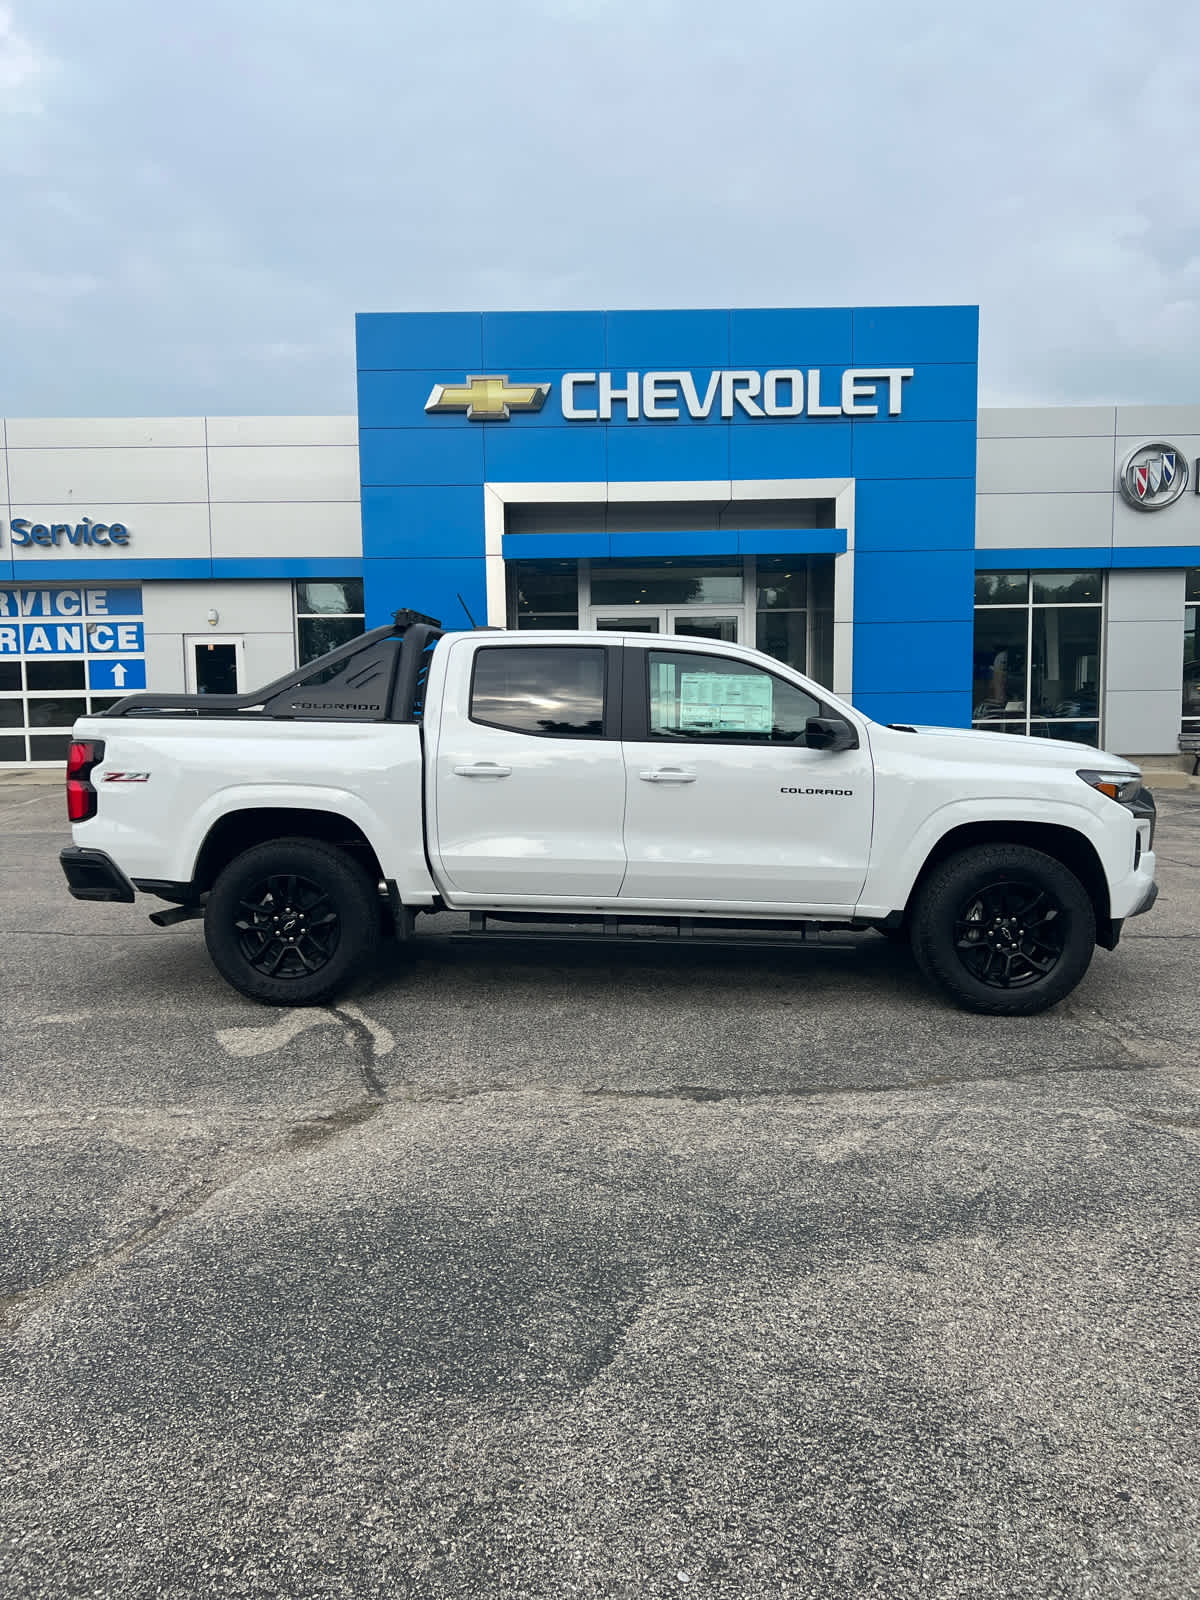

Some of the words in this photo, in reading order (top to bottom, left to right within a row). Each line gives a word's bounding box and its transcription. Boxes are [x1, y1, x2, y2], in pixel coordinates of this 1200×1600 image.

[561, 368, 914, 419] CHEVROLET
[11, 517, 128, 546] Service
[290, 702, 380, 711] COLORADO
[104, 772, 150, 782] Z71
[780, 787, 853, 796] COLORADO
